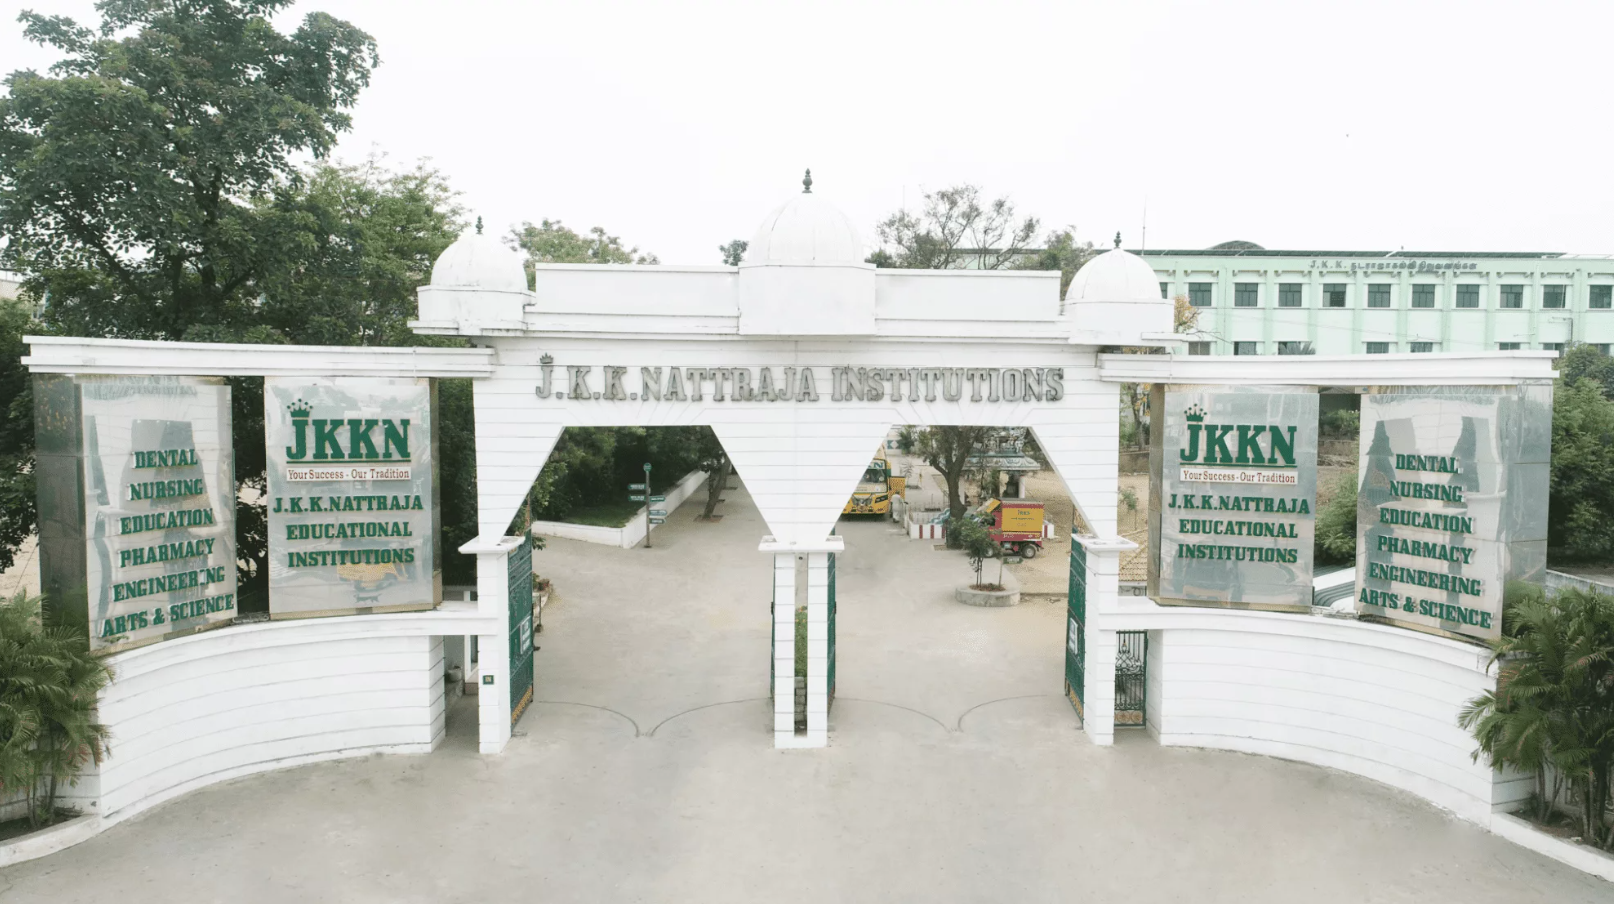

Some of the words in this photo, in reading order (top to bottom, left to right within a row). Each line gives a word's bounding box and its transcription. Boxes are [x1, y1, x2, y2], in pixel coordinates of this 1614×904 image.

[536, 366, 819, 402] J.K.K.NATTRAJA
[831, 368, 1065, 402] INSTITUTIONS
[286, 418, 410, 460] JKKN
[1180, 424, 1297, 464] JKKN
[135, 449, 197, 469] DENTAL
[1395, 454, 1459, 474] DENTAL
[288, 469, 309, 480] Your
[310, 469, 344, 480] Success
[351, 469, 367, 480] Our
[370, 468, 410, 479] Tradition
[1183, 470, 1202, 481] Your
[1203, 471, 1235, 482] Success
[1240, 472, 1255, 483] Our
[1257, 473, 1296, 484] Tradition
[130, 479, 203, 501] NURSING
[1389, 481, 1463, 503] NURSING
[273, 495, 423, 513] J.K.K.NATTRAJA
[1168, 494, 1310, 514] J.K.K.NATTRAJA
[121, 509, 212, 535] EDUCATION
[287, 522, 412, 540] EDUCATIONAL
[1179, 519, 1297, 538] EDUCATIONAL
[1380, 508, 1472, 534] EDUCATION
[120, 538, 215, 567] PHARMACY
[288, 548, 414, 568] INSTITUTIONS
[1178, 544, 1297, 563] INSTITUTIONS
[1377, 535, 1473, 565] PHARMACY
[114, 566, 226, 602] ENGINEERING
[1370, 562, 1480, 597] ENGINEERING
[102, 611, 149, 637] ARTS
[152, 609, 165, 625] &
[170, 594, 234, 621] SCIENCE
[1359, 588, 1398, 610] ARTS
[1403, 597, 1415, 612] &
[1419, 599, 1492, 629] SCIENCE
